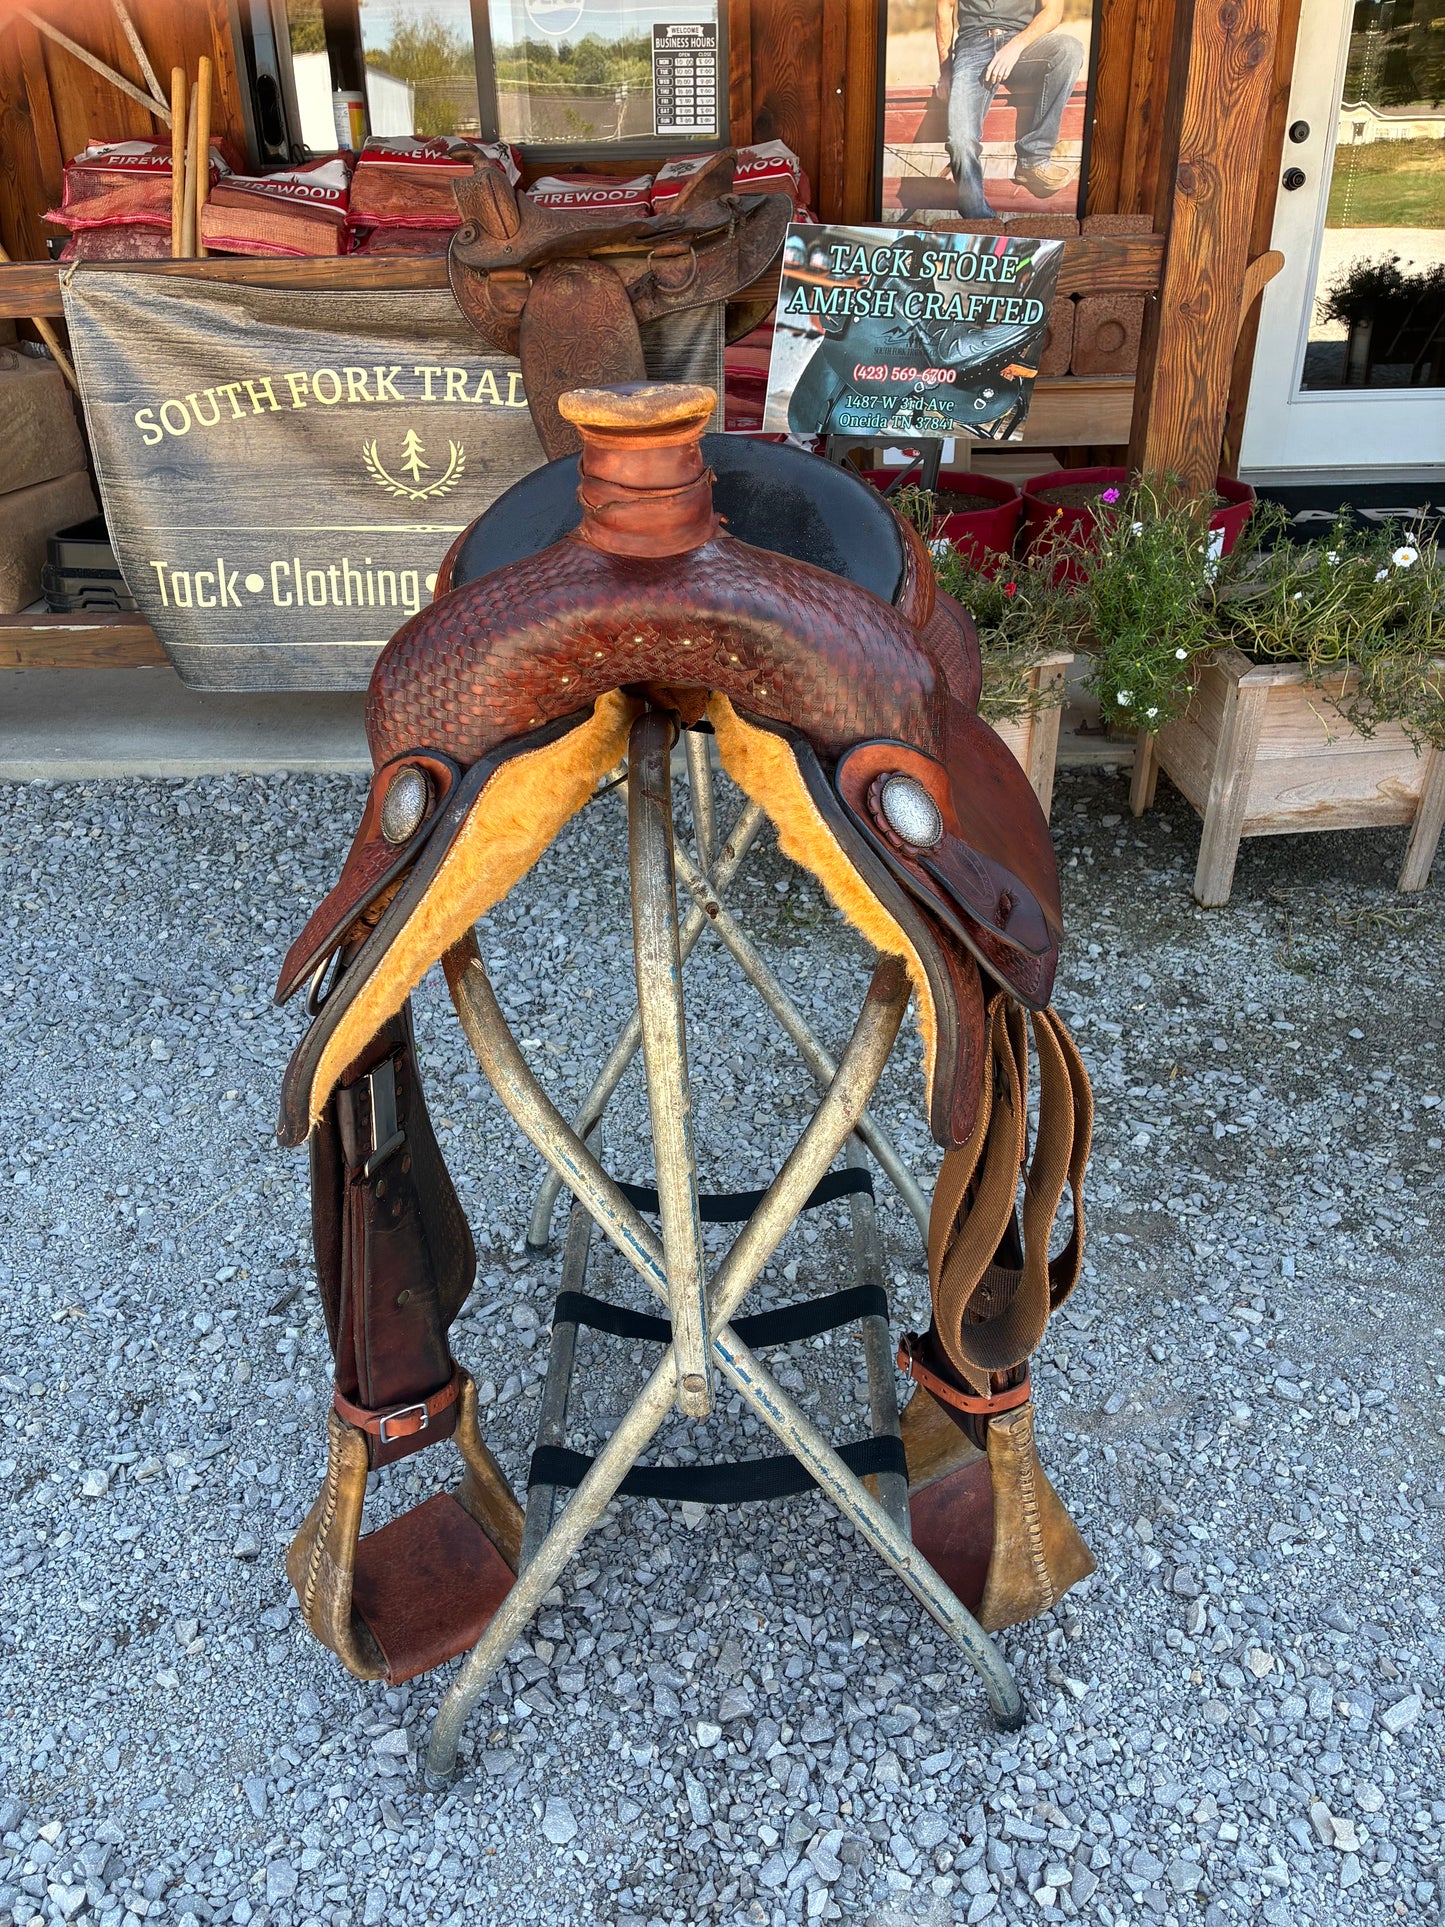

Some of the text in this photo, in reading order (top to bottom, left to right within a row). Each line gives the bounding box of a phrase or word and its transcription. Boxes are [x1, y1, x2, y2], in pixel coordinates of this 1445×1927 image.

[655, 37, 715, 48] BUSINESS HOURS
[232, 180, 340, 200] FIREWOOD
[533, 189, 639, 204] FIREWOOD
[830, 244, 1019, 284] TACK STORE
[785, 286, 1044, 325] AMISH CRAFTED
[853, 363, 957, 384] (423) 569-6700
[134, 376, 281, 447] SOUTH
[283, 366, 405, 409] FORK
[845, 395, 955, 412] 1487 W 3rd Ave
[839, 413, 955, 431] Oneida TN 37841
[149, 556, 421, 616] Tack Clothing
